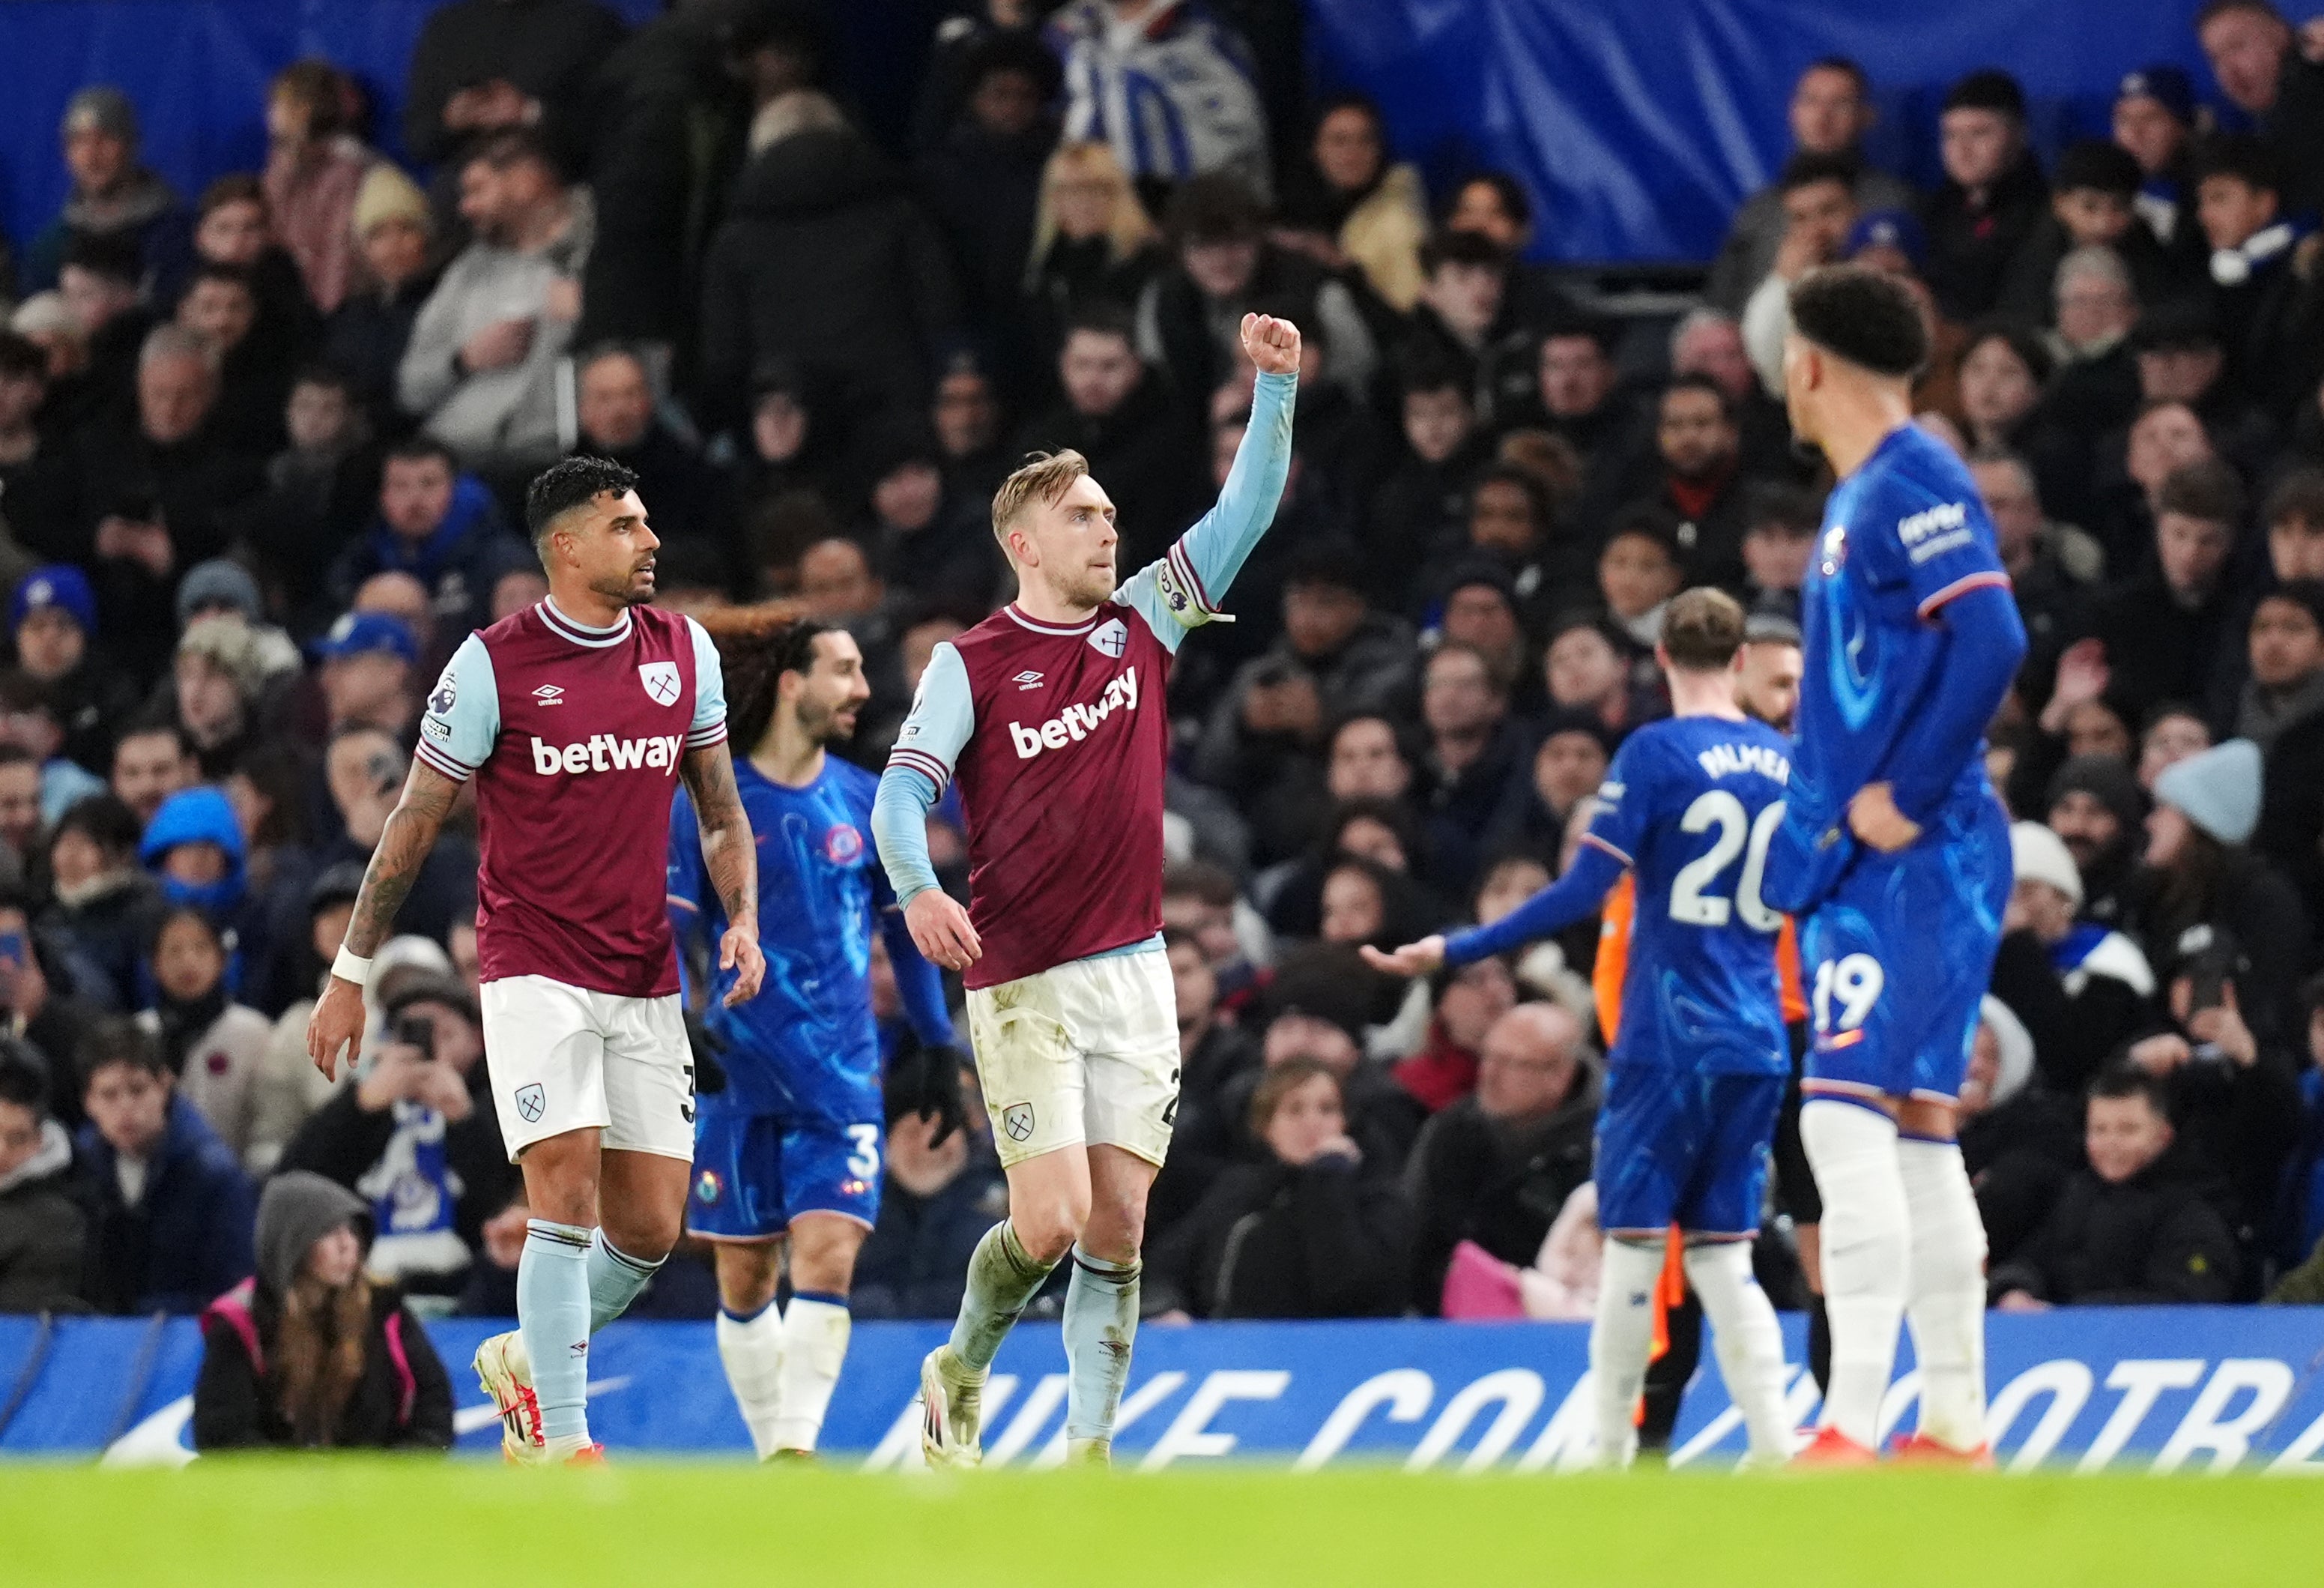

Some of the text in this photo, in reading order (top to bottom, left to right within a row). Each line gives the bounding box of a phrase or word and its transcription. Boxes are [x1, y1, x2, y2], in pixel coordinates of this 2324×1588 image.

[537, 698, 563, 707] umbro
[1008, 665, 1137, 759] betway
[1018, 681, 1044, 691] umbro
[531, 734, 683, 776] betway
[1669, 789, 1786, 934] 20
[1812, 953, 1884, 1031] 19
[847, 1124, 880, 1179] 3
